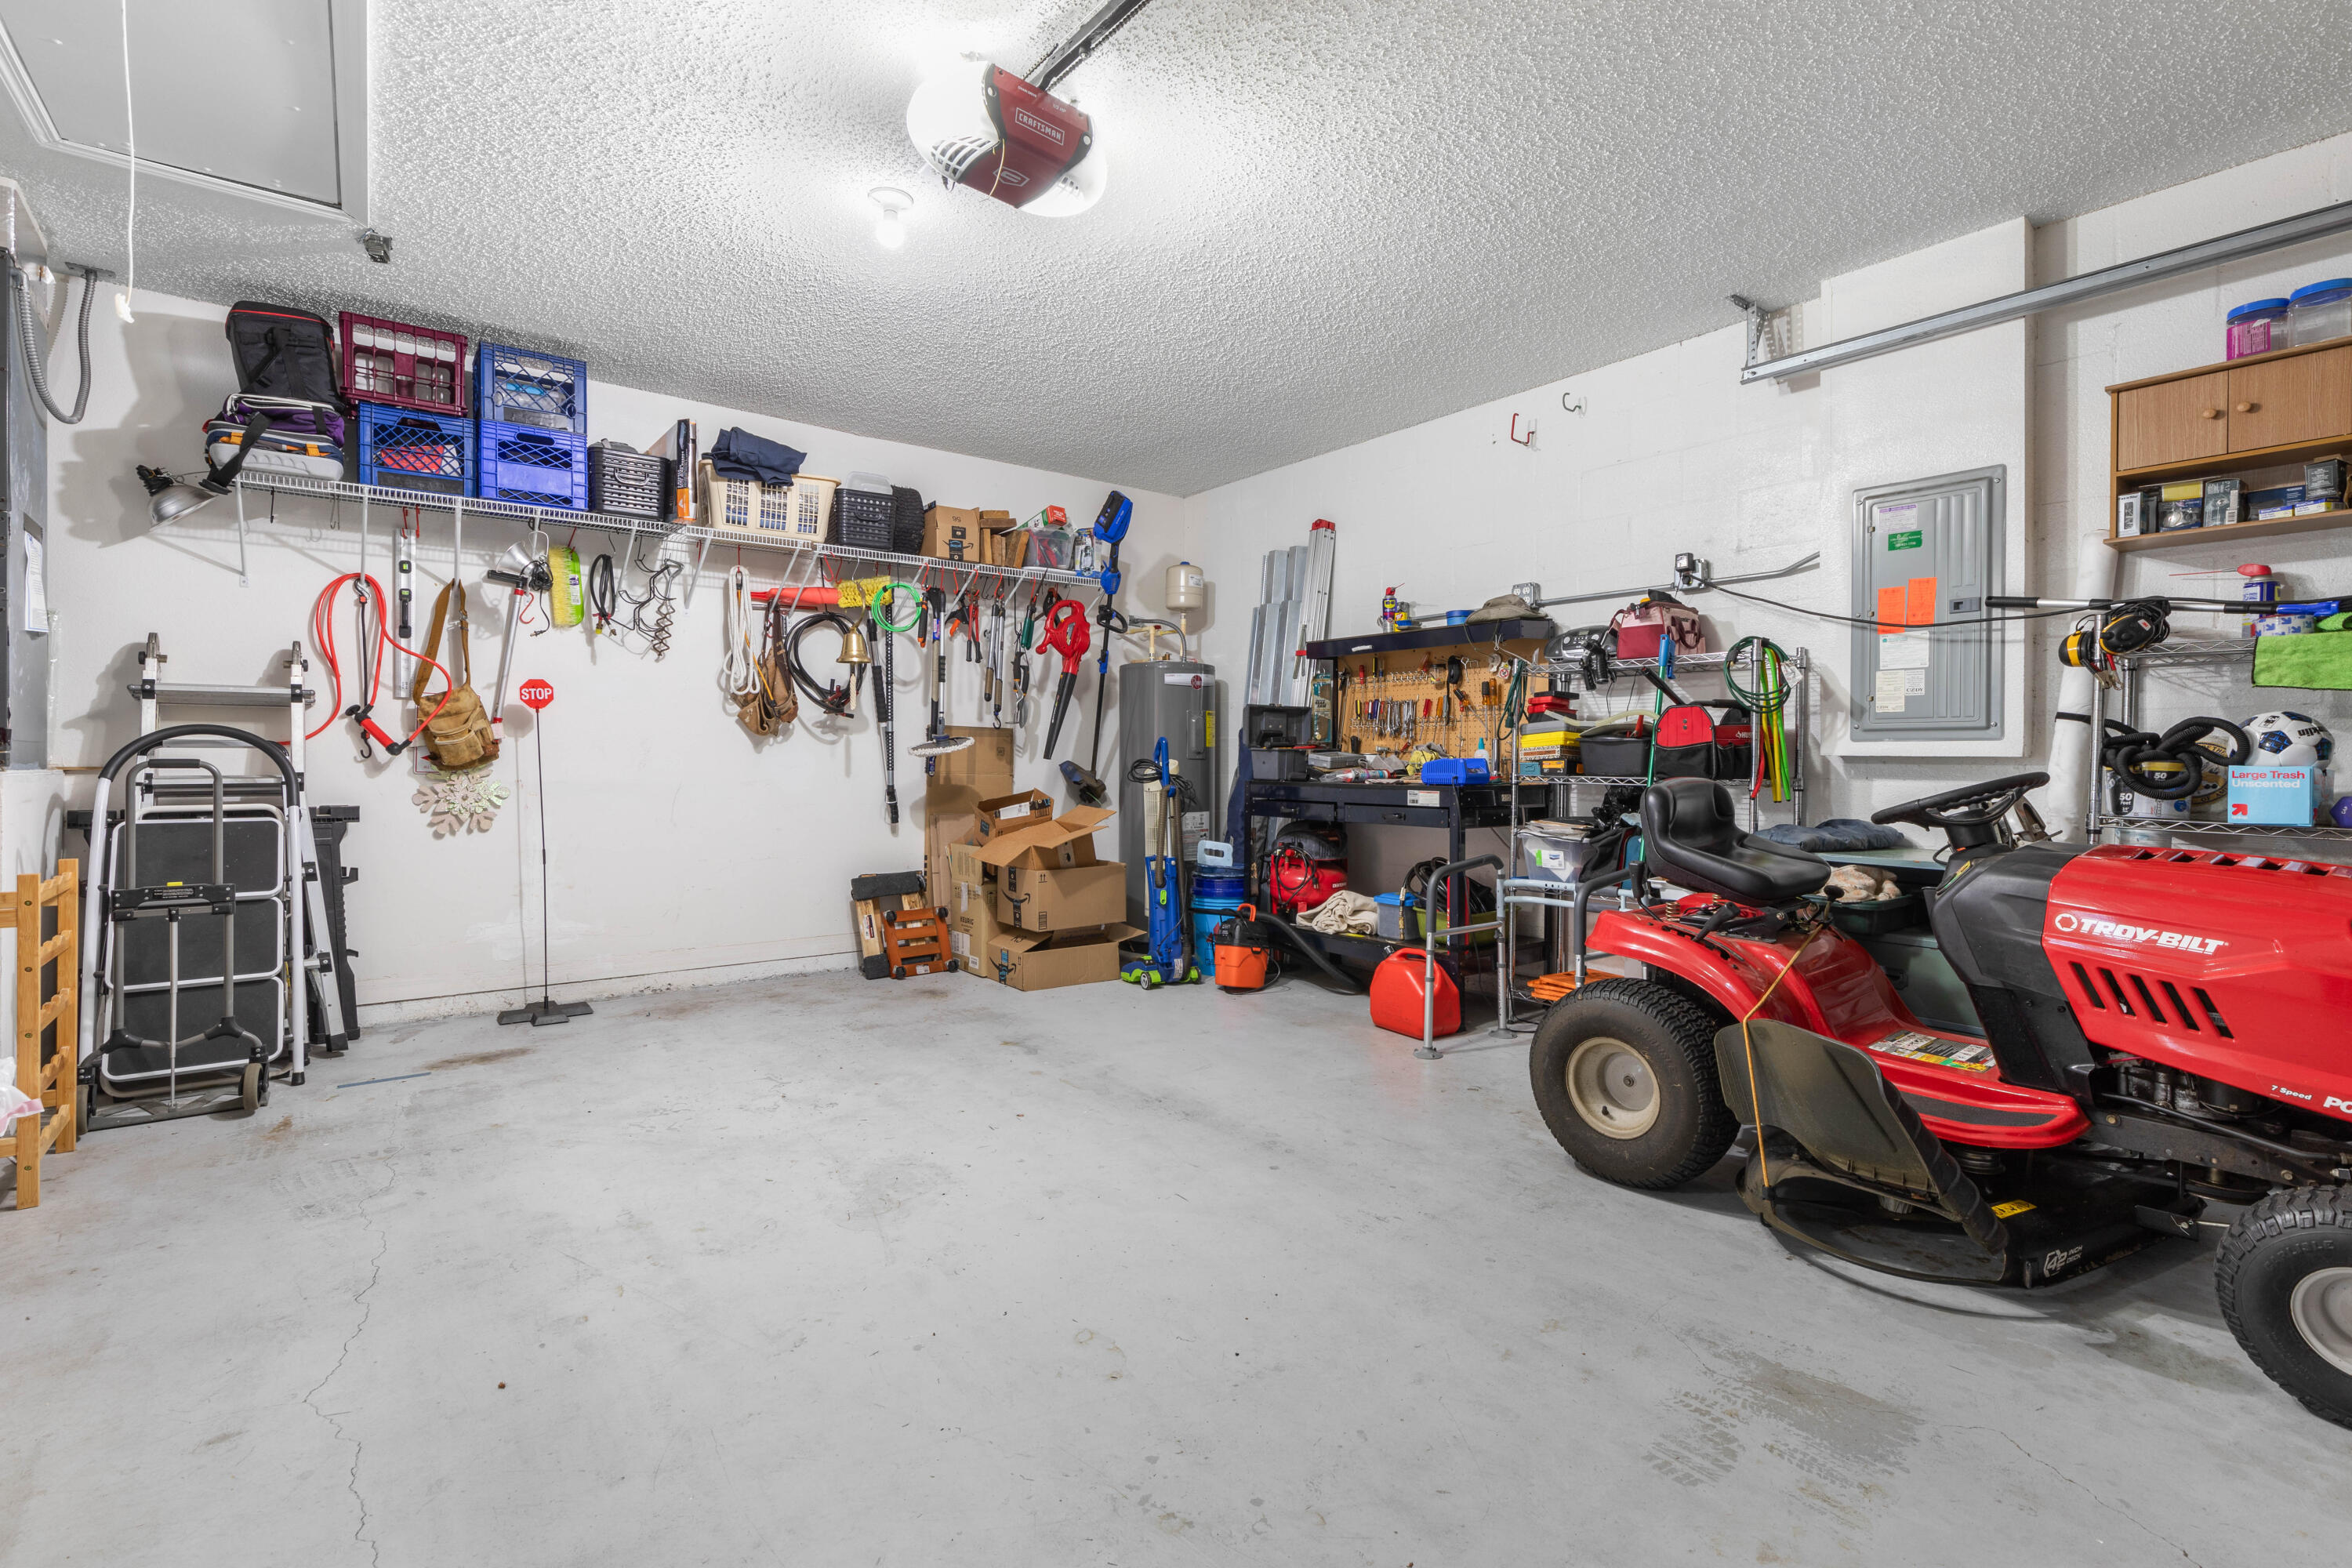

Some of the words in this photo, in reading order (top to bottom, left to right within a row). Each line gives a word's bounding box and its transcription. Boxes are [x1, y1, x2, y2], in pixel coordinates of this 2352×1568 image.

[1019, 113, 1062, 140] CRAFTSMAN
[521, 688, 552, 700] STOP
[2232, 771, 2267, 780] Large
[2270, 771, 2305, 779] Trash
[2232, 779, 2300, 788] Unscented
[2080, 918, 2224, 955] TROY-BILT
[2280, 1087, 2312, 1100] Speed
[2047, 1251, 2067, 1270] 42
[2068, 1245, 2082, 1255] INCH
